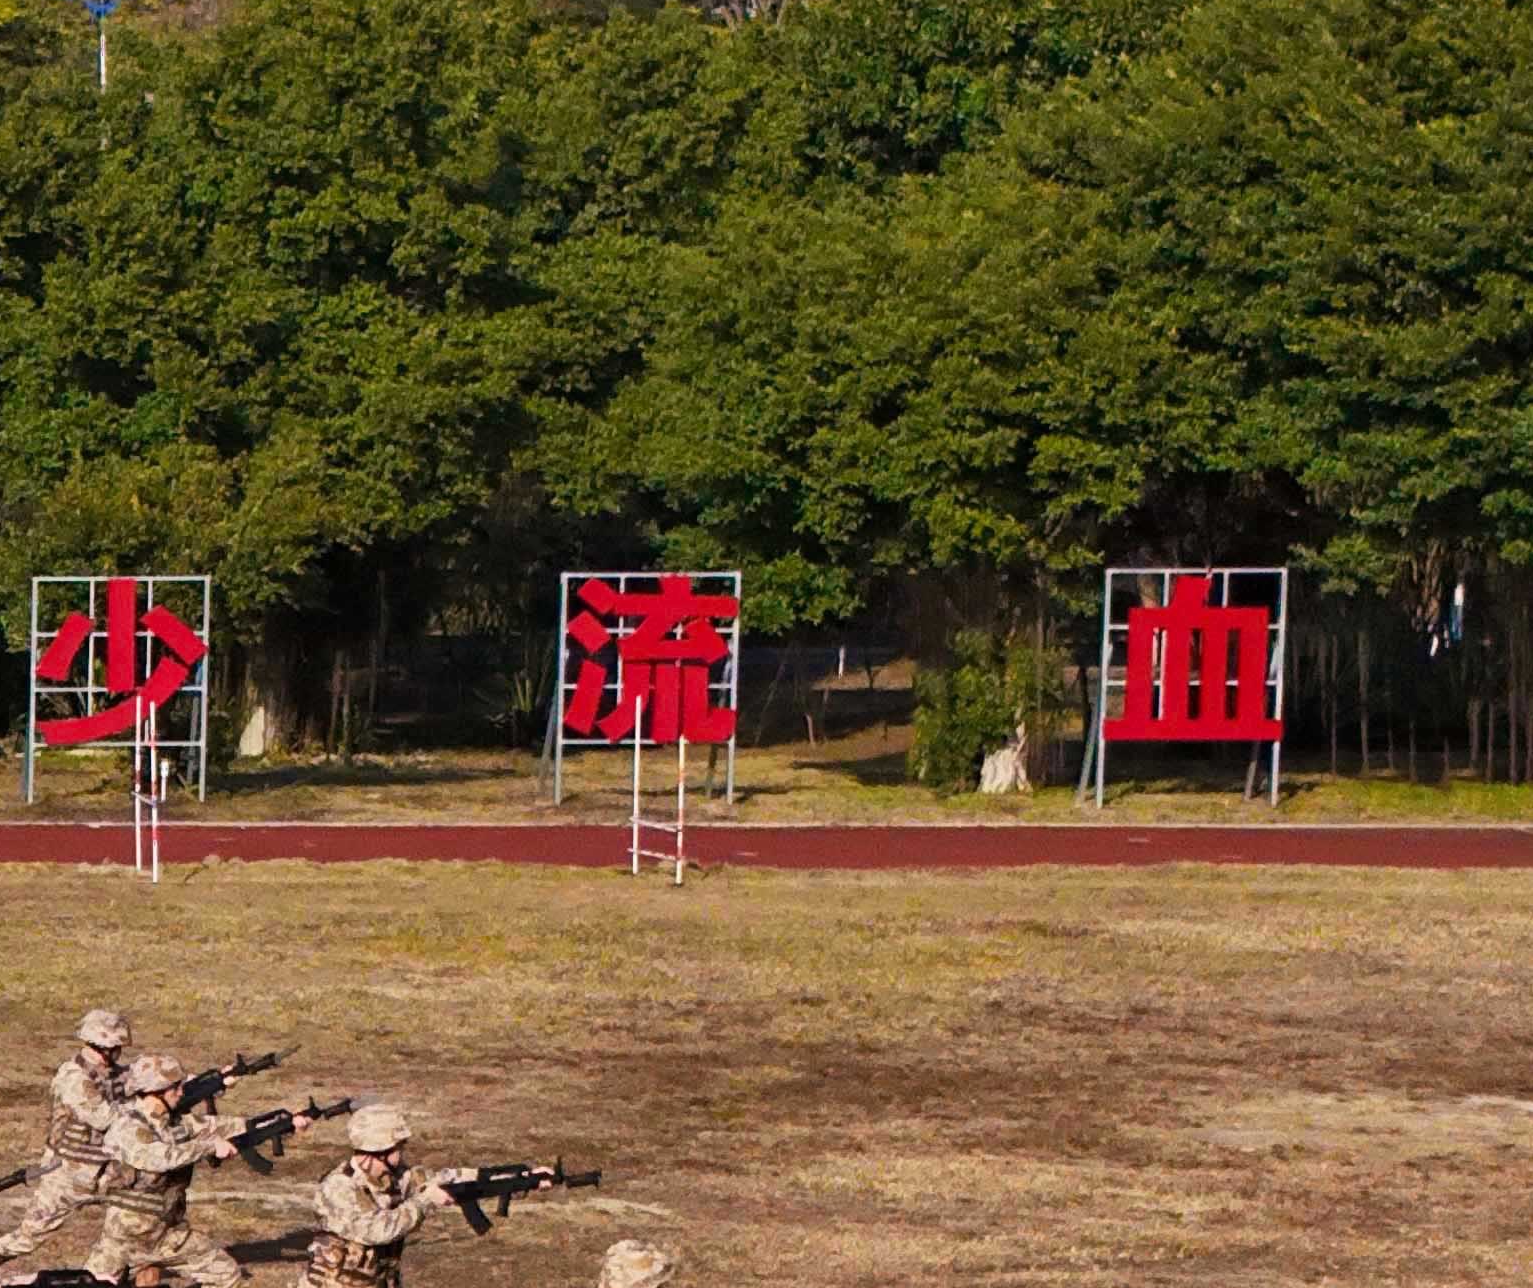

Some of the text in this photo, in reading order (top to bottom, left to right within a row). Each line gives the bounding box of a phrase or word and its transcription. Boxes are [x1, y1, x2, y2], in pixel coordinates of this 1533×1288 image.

[35, 578, 209, 746] 少
[562, 573, 740, 745] 流
[1102, 574, 1284, 742] 血
